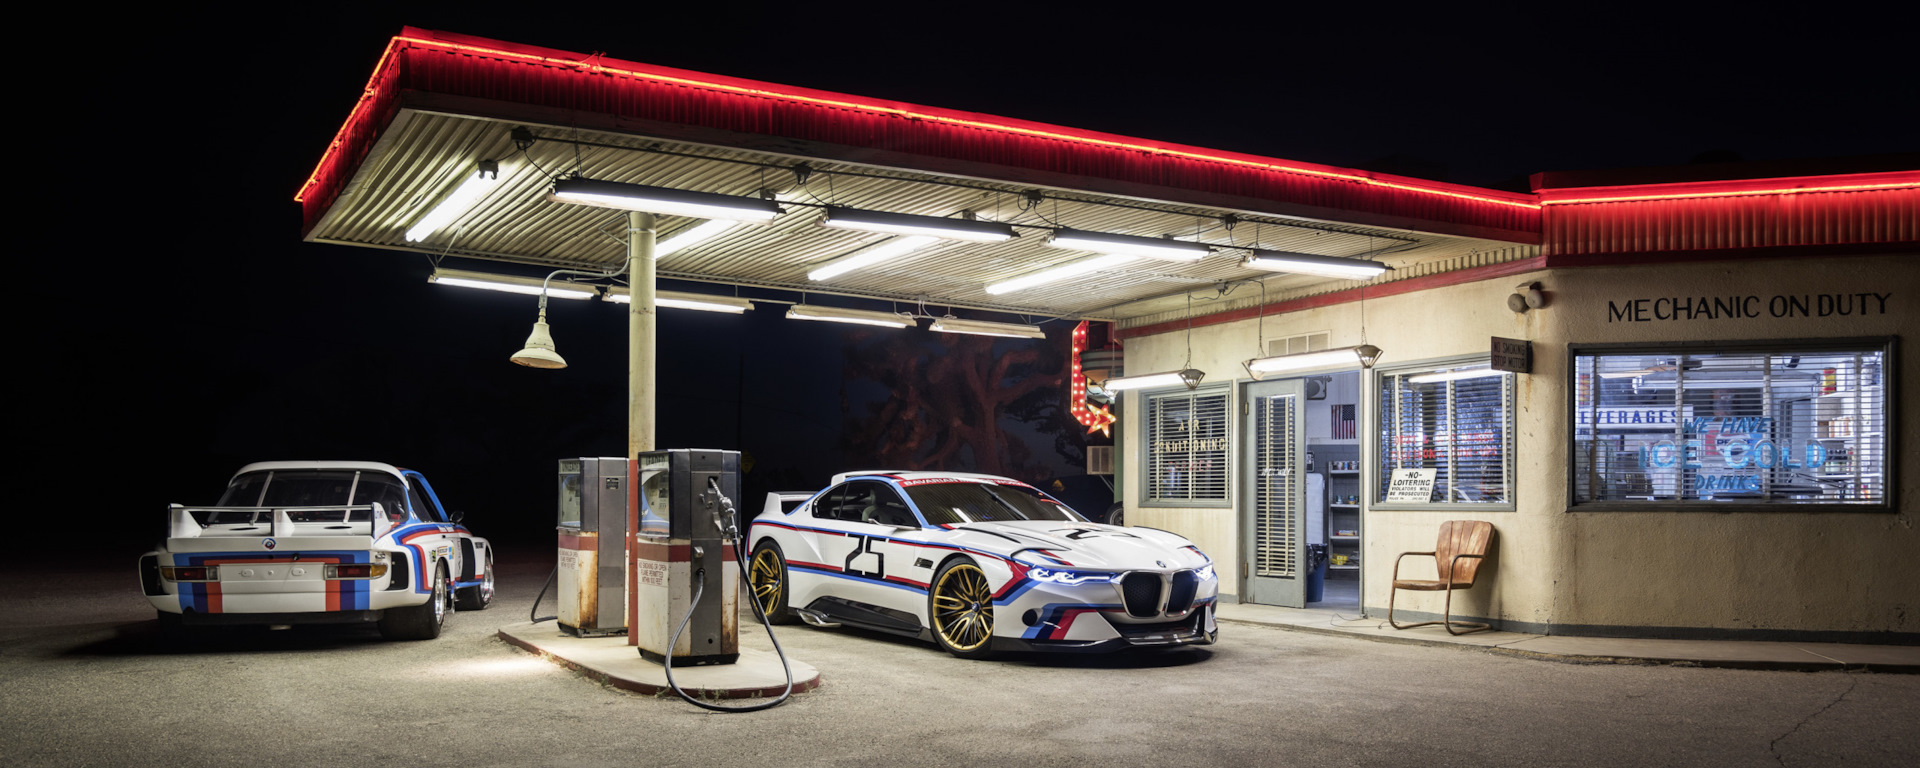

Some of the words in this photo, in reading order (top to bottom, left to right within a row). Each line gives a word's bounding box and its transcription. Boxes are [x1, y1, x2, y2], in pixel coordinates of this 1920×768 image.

[1608, 295, 1760, 322] MECHANIC
[1769, 294, 1809, 318] ON
[1817, 293, 1892, 318] DUTY
[1493, 341, 1501, 353] NO
[1503, 342, 1526, 356] SMOKING
[1493, 354, 1507, 367] STOP
[1508, 357, 1526, 369] MOTOR
[1684, 416, 1715, 433] WE
[1721, 416, 1774, 433] HAVE
[1154, 438, 1225, 454] CONDITONING
[1638, 439, 1702, 469] ICE
[1724, 439, 1827, 469] COLD
[903, 477, 958, 487] BAVARIAN
[1694, 474, 1760, 491] DRINKS
[845, 532, 885, 579] 25
